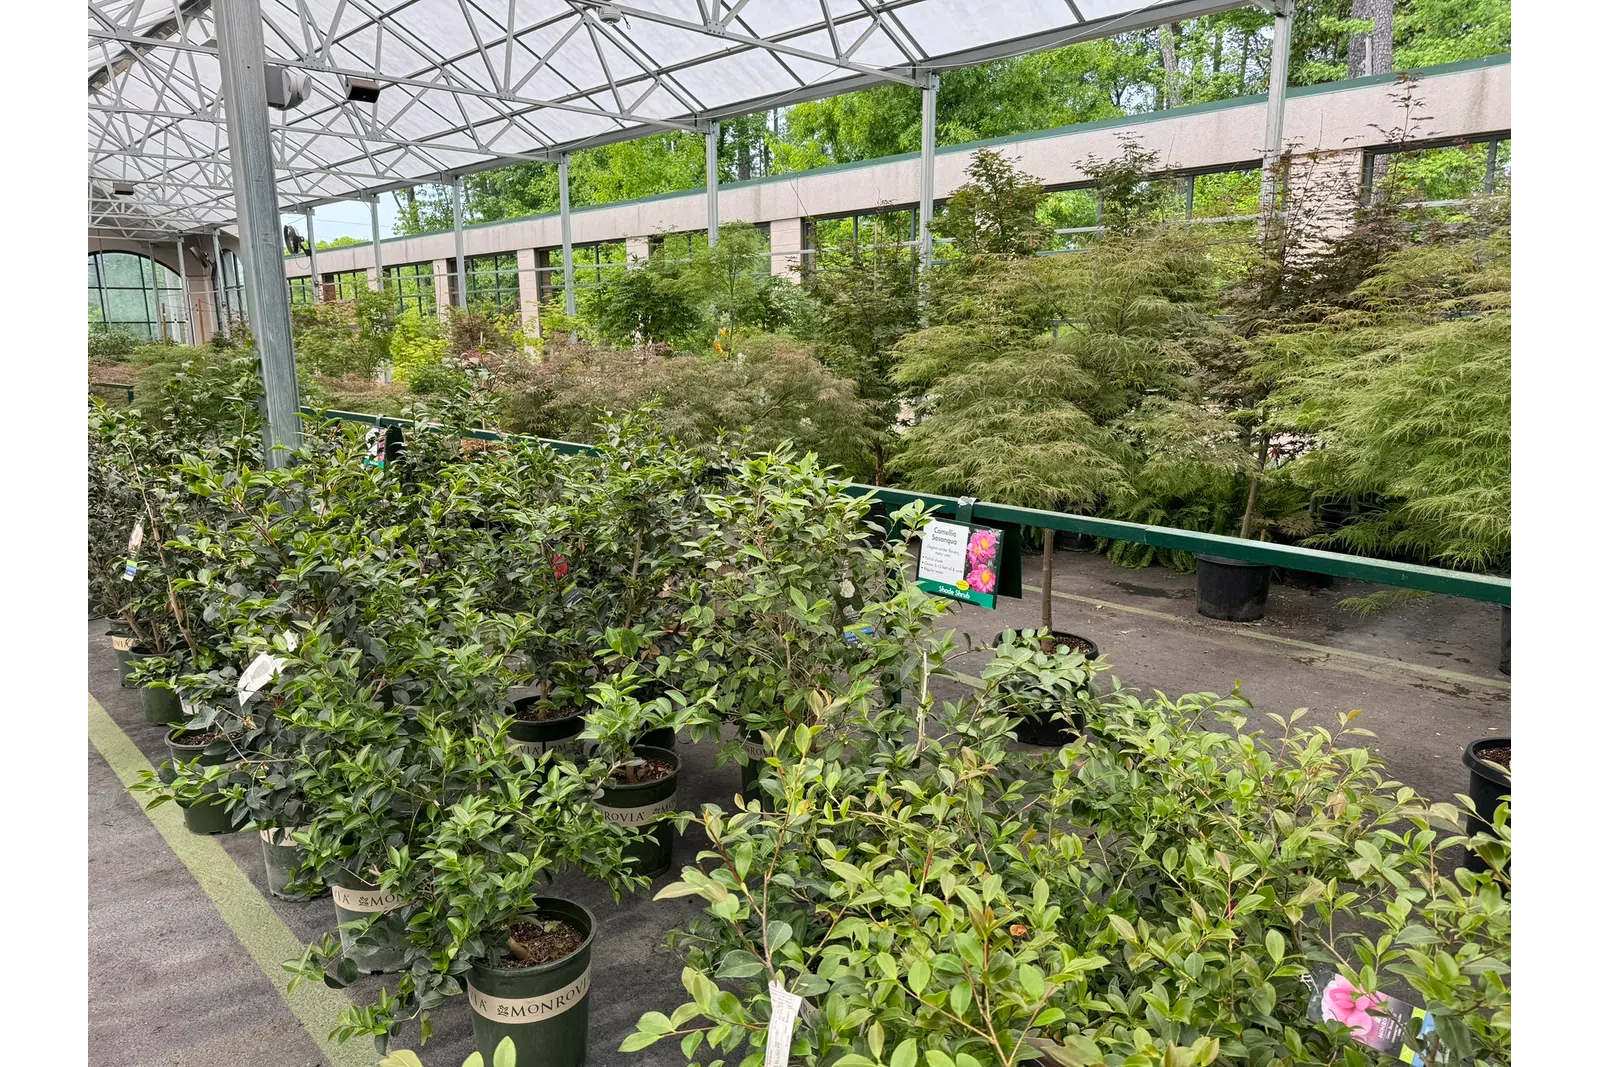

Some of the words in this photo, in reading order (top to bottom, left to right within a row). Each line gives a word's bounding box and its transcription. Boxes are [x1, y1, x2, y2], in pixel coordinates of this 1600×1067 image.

[934, 526, 956, 537] Camellia
[932, 534, 957, 545] Sasanqua
[938, 586, 954, 595] Shade
[955, 590, 970, 599] Shrub
[602, 810, 645, 822] ROVIA
[510, 973, 590, 1017] MONROVI
